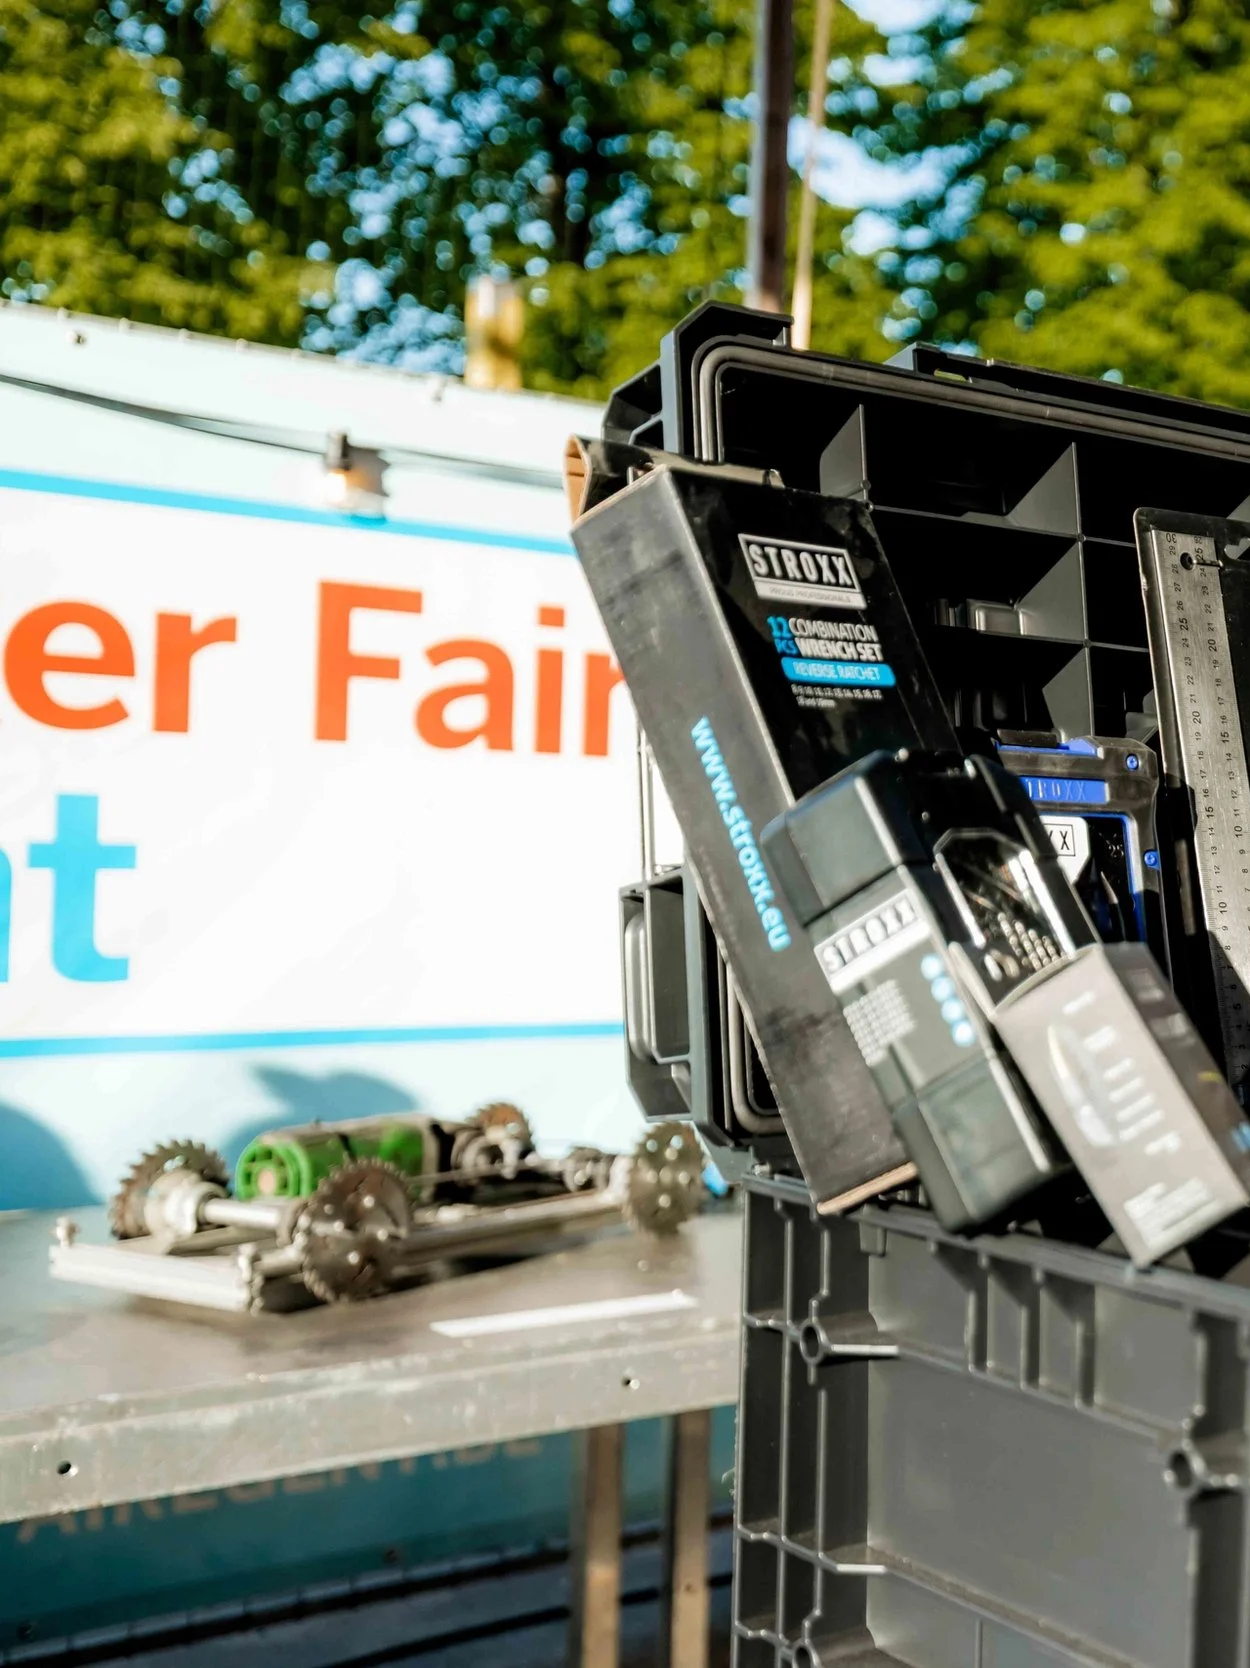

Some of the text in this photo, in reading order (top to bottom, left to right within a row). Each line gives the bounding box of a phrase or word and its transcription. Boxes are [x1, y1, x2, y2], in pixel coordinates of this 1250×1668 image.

[1166, 532, 1177, 544] 30
[1168, 545, 1176, 555] 29
[1194, 547, 1203, 560] 25
[748, 544, 853, 586] STROXX
[1172, 563, 1179, 574] 28
[1200, 567, 1207, 577] 24
[1174, 582, 1181, 593] 27
[1202, 586, 1209, 596] 23
[1177, 600, 1184, 611] 26
[1205, 604, 1212, 614] 22
[767, 616, 878, 642] 12 COMBINATION
[1180, 618, 1189, 632] 25
[1208, 622, 1215, 632] 21
[1182, 638, 1189, 648] 24
[1207, 639, 1217, 652] 20
[795, 638, 859, 660] WRENCH
[856, 643, 883, 661] SET
[1185, 656, 1192, 666] 23
[1212, 659, 1219, 669] 19
[792, 662, 880, 680] REVERSE RATCHET
[1187, 675, 1194, 685] 22
[1215, 678, 1222, 688] 18
[1190, 693, 1197, 703] 21
[1217, 697, 1225, 706] 17
[1192, 710, 1201, 724] 20
[1220, 715, 1228, 724] 16
[1195, 732, 1201, 741] 19
[1220, 732, 1229, 744] 15
[1197, 751, 1204, 760] 18
[1225, 752, 1233, 761] 14
[1200, 770, 1207, 779] 17
[1228, 771, 1236, 780] 13
[1025, 779, 1086, 800] TROXX
[1202, 788, 1210, 798] 16
[1231, 790, 1238, 799] 12
[1205, 806, 1214, 819] 15
[1233, 808, 1241, 817] 11
[691, 716, 791, 952] www.stroxx.eu
[1208, 827, 1215, 836] 14
[1233, 825, 1243, 838] 10
[1211, 846, 1218, 855] 13
[1214, 865, 1221, 874] 12
[1217, 885, 1223, 893] 11
[1218, 901, 1228, 914] 10
[823, 900, 916, 973] STROXX
